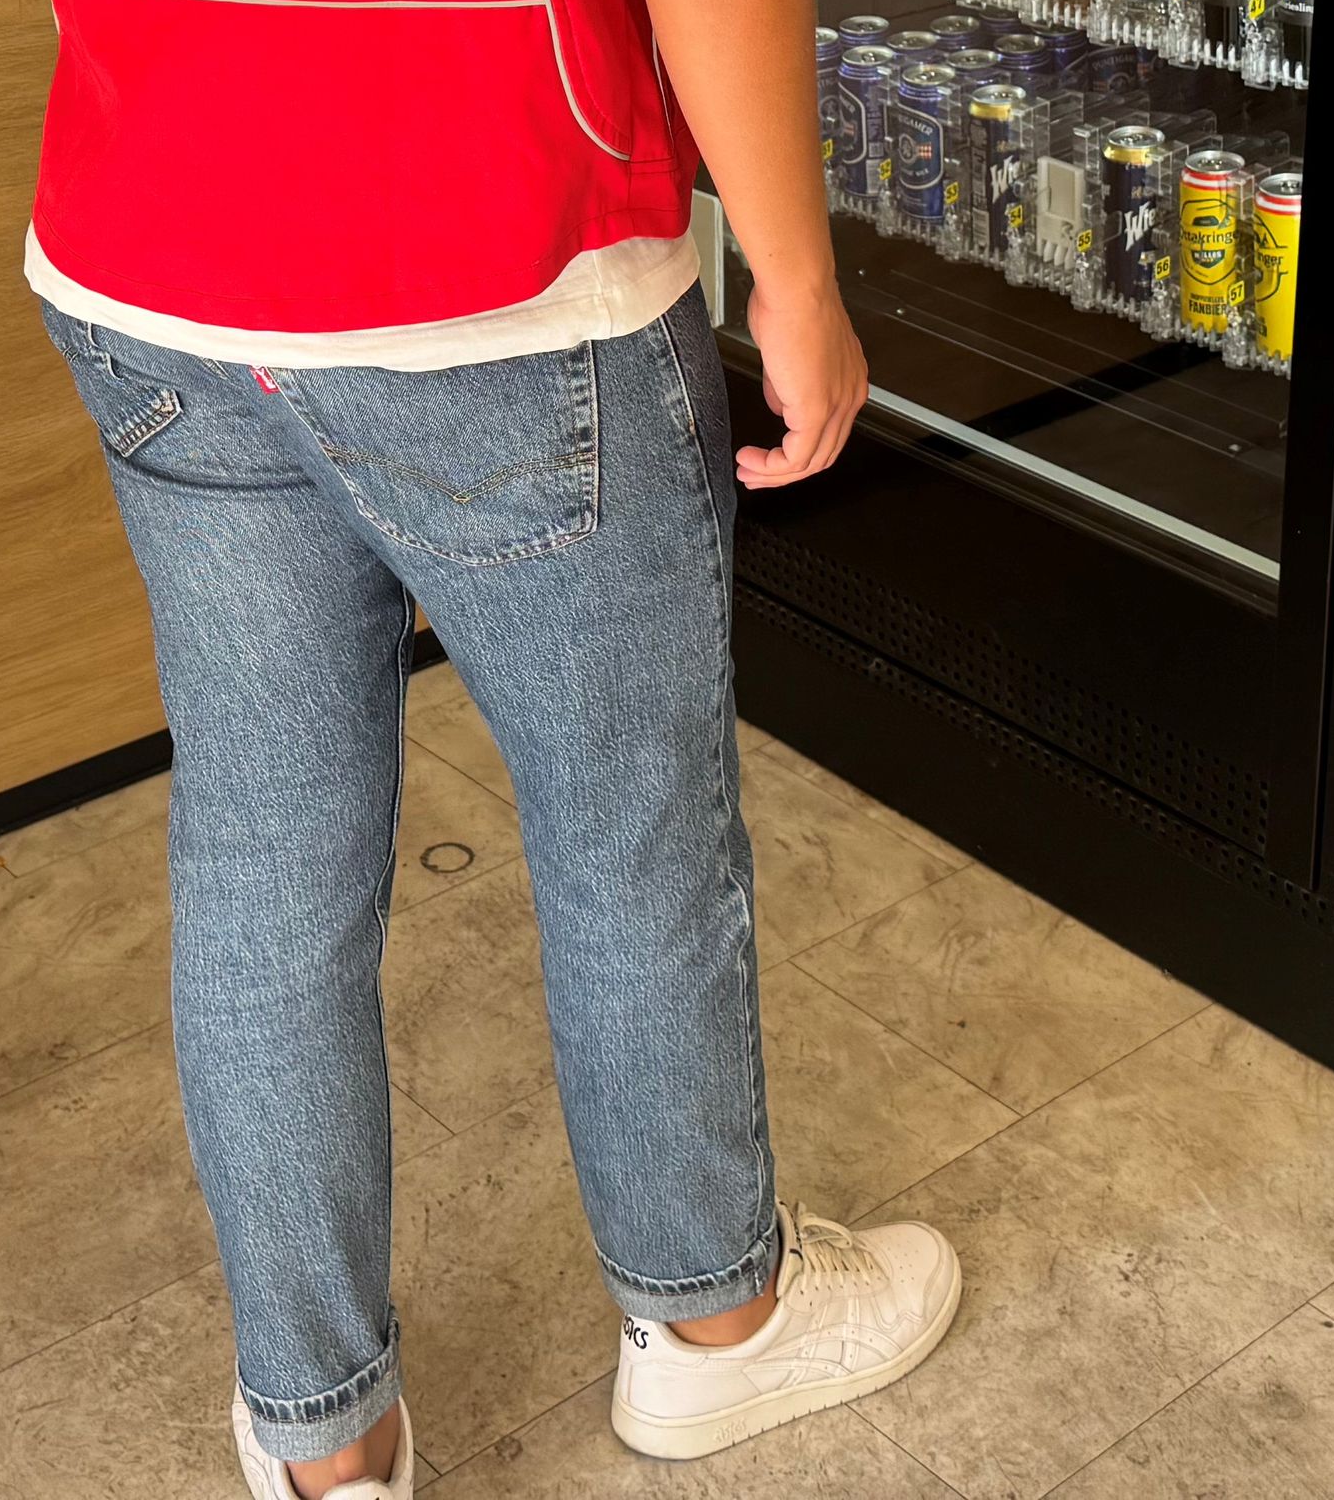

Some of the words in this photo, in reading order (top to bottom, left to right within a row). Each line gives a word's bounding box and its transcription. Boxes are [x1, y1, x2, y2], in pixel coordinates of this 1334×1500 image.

[1078, 233, 1091, 247] 55
[1157, 260, 1169, 276] 56
[1230, 285, 1243, 302] 57
